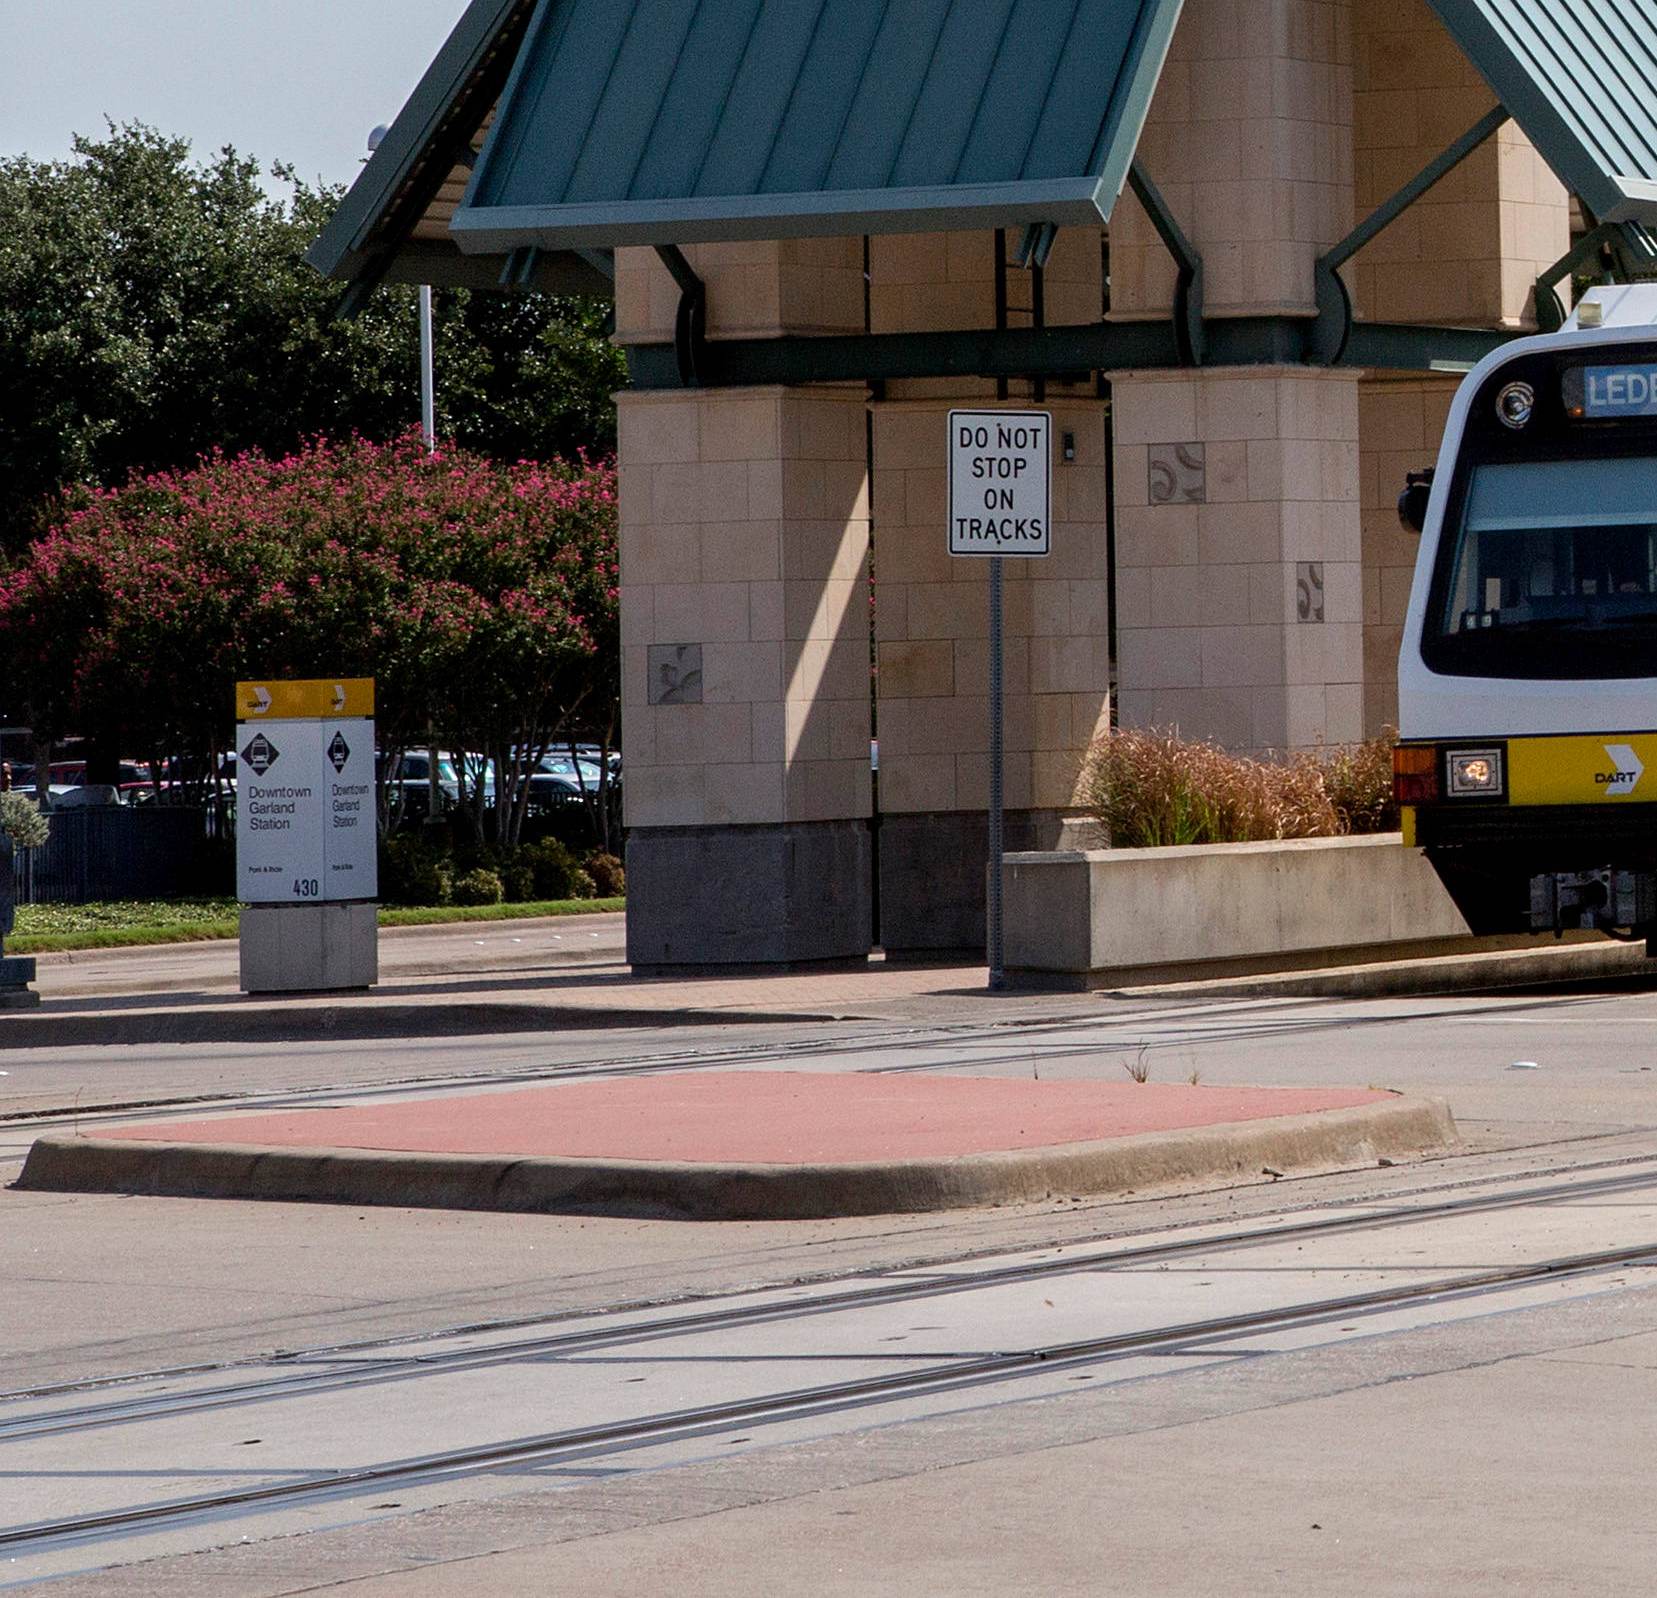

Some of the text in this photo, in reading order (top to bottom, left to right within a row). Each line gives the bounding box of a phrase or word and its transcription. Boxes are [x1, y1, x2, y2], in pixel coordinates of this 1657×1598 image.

[960, 426, 1041, 449] DO NOT
[972, 456, 1027, 478] STOP
[984, 488, 1014, 510] ON
[956, 518, 1042, 540] TRACKS
[1594, 771, 1636, 784] DART
[249, 786, 312, 799] Downtown
[332, 784, 369, 797] Downtown
[249, 802, 296, 815] Garland
[332, 800, 360, 812] Garland
[250, 818, 290, 830] Station
[333, 815, 358, 828] Station
[293, 879, 319, 897] 430
